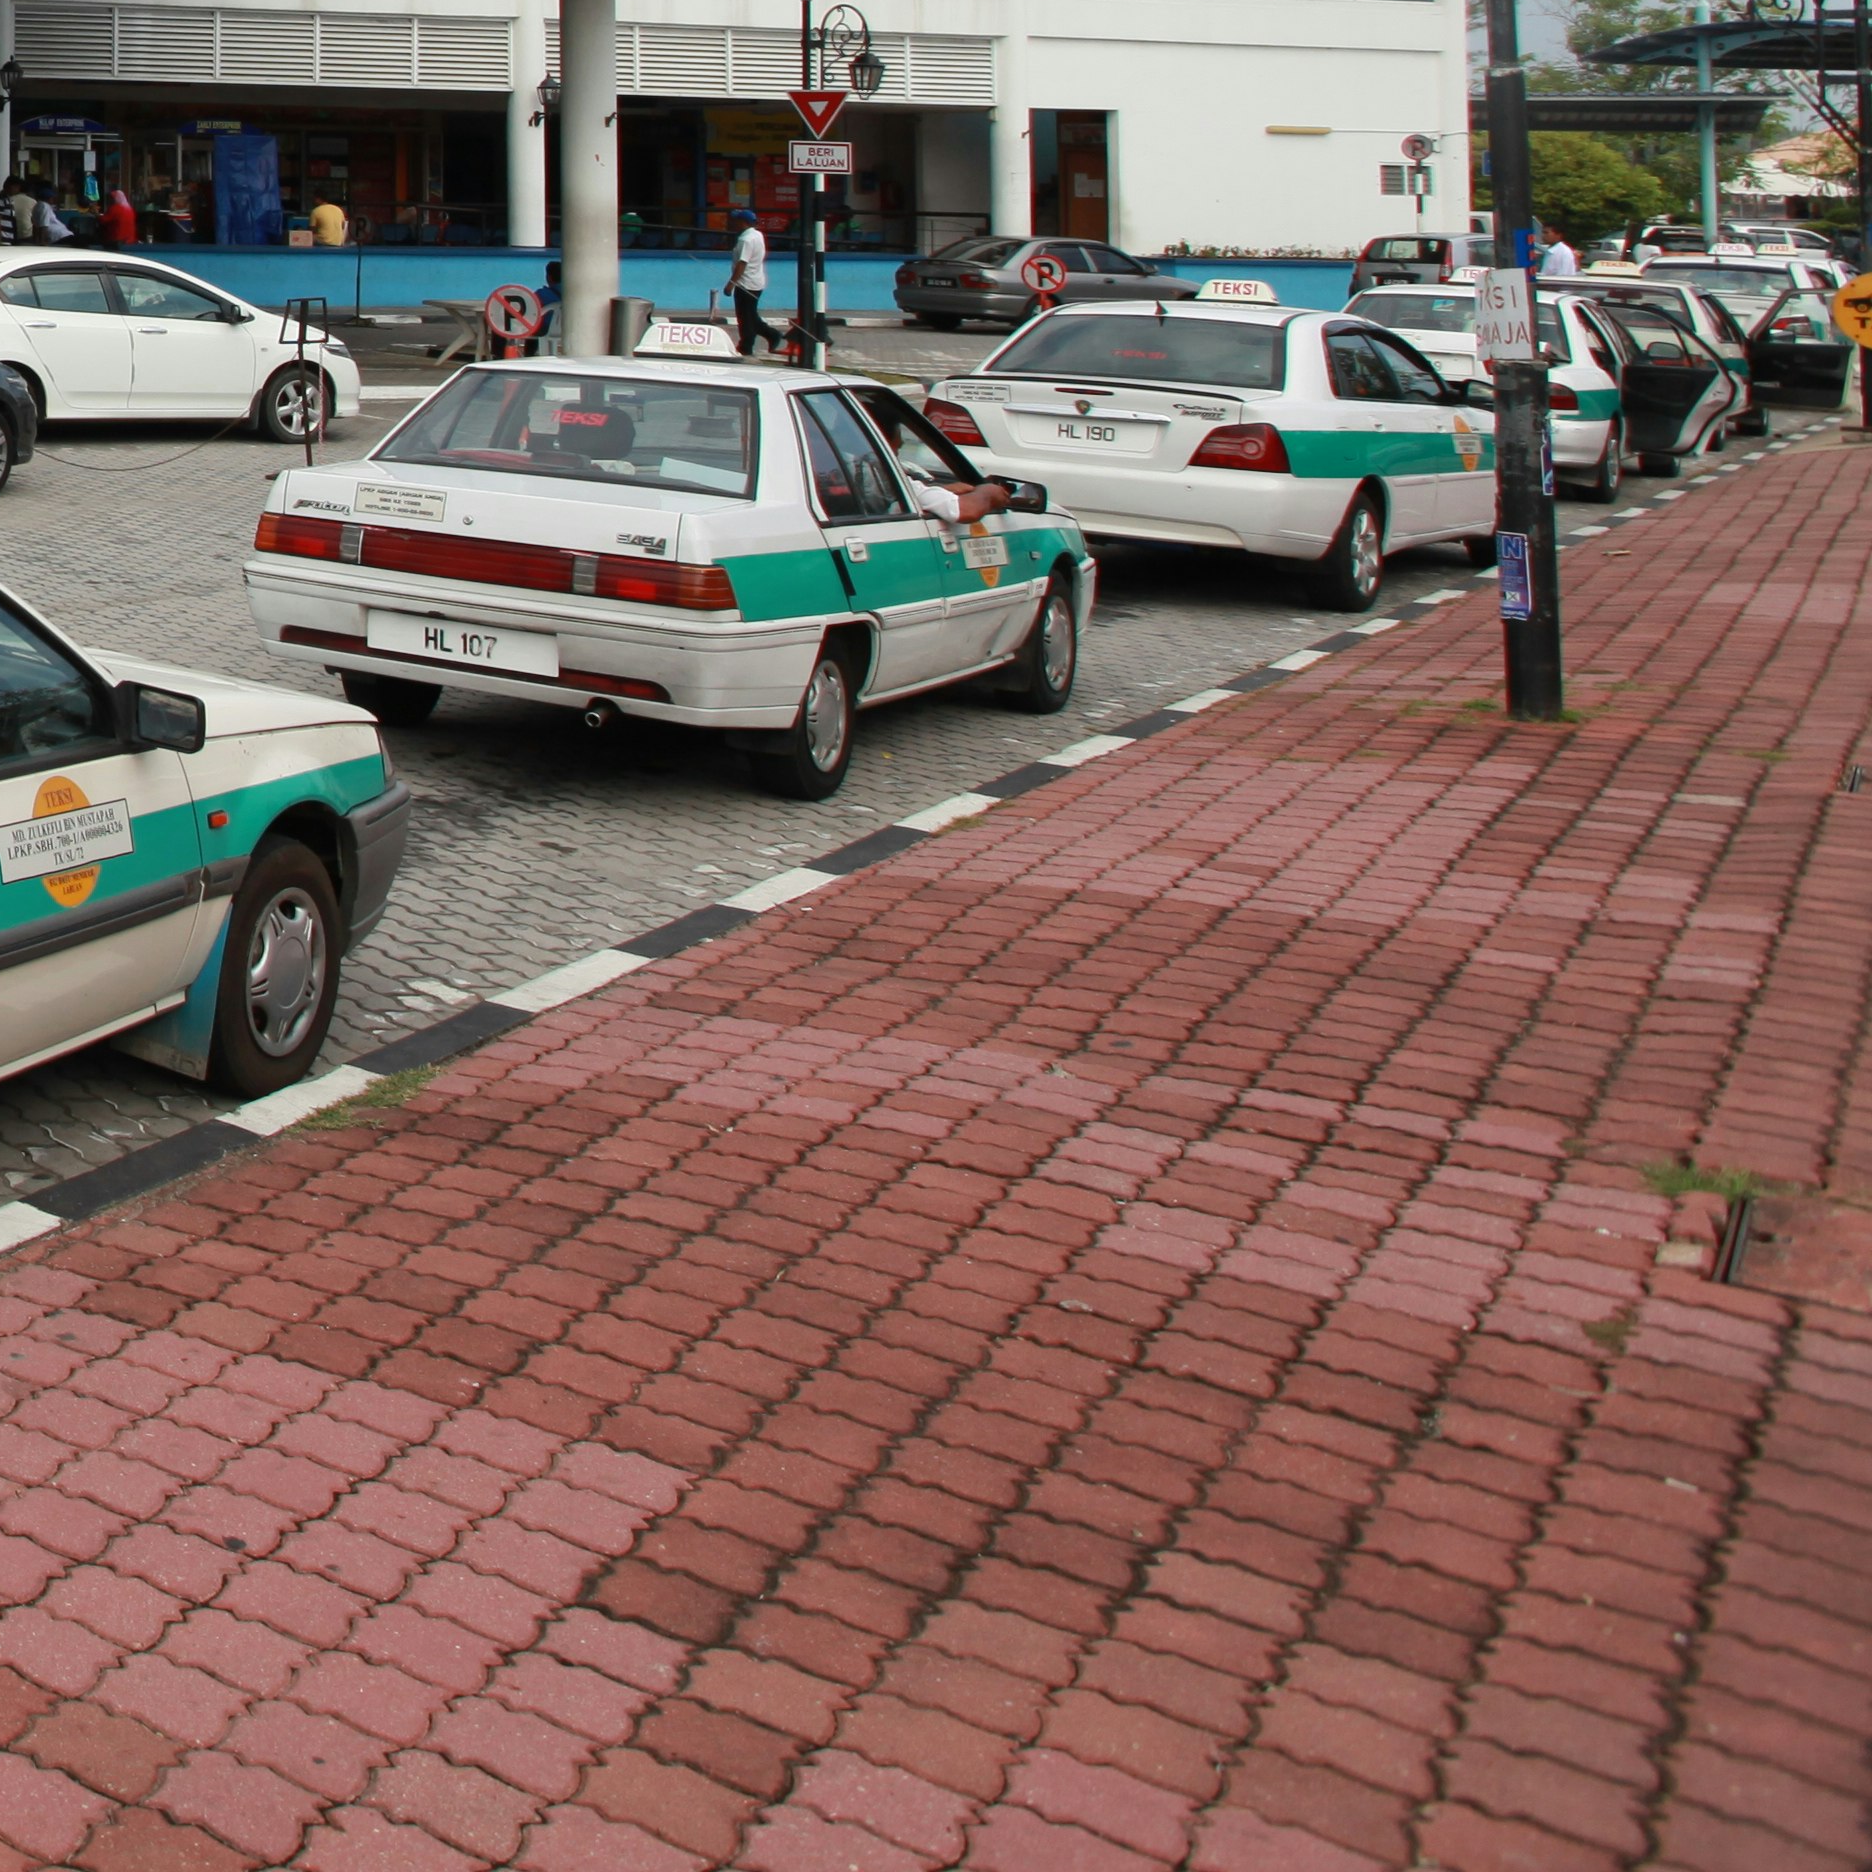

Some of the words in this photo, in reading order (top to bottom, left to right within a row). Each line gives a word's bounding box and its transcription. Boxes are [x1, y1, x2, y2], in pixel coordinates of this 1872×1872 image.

[808, 148, 834, 156] BERI
[797, 157, 844, 167] LALUAN
[1212, 281, 1257, 296] TEKSI
[657, 325, 712, 345] TEKSI
[549, 408, 609, 427] TEKSI
[1058, 424, 1081, 440] HL
[1086, 425, 1115, 442] 190
[424, 626, 453, 653] HL
[460, 632, 498, 659] 107
[44, 787, 74, 809] TEKSI
[63, 819, 76, 831] BIN
